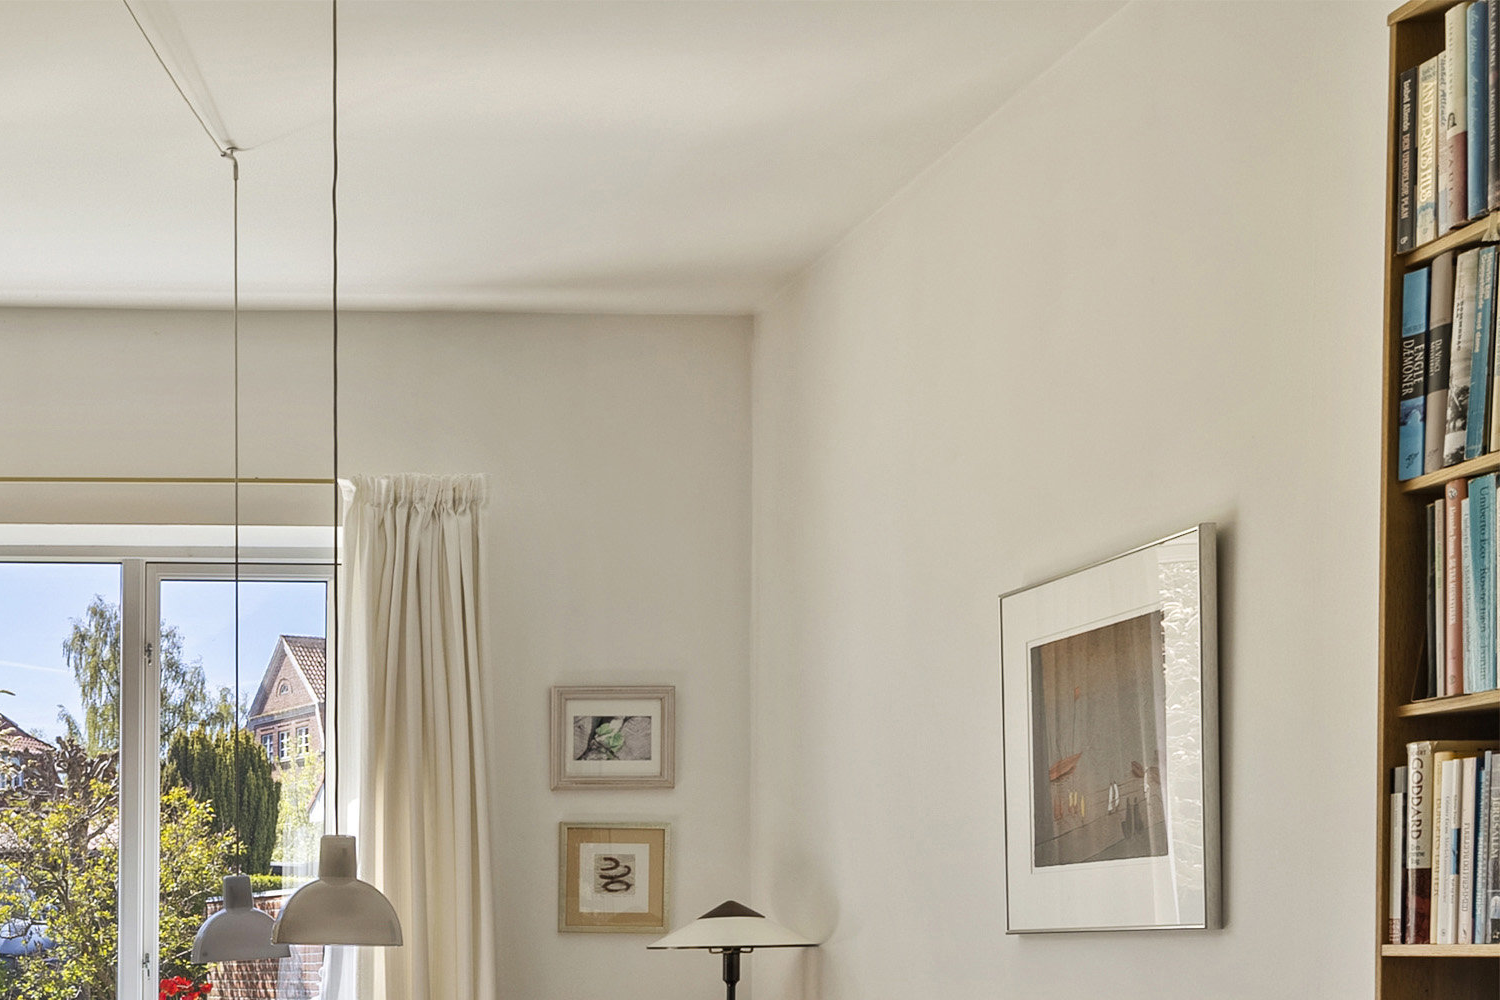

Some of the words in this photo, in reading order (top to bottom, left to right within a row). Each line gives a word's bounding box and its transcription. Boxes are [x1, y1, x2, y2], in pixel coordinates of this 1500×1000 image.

[1402, 339, 1415, 397] DÆMONER
[1414, 343, 1426, 384] ENGLE
[1479, 486, 1490, 535] Umberto
[1479, 537, 1489, 559] Eco
[1411, 757, 1424, 841] GODDARD
